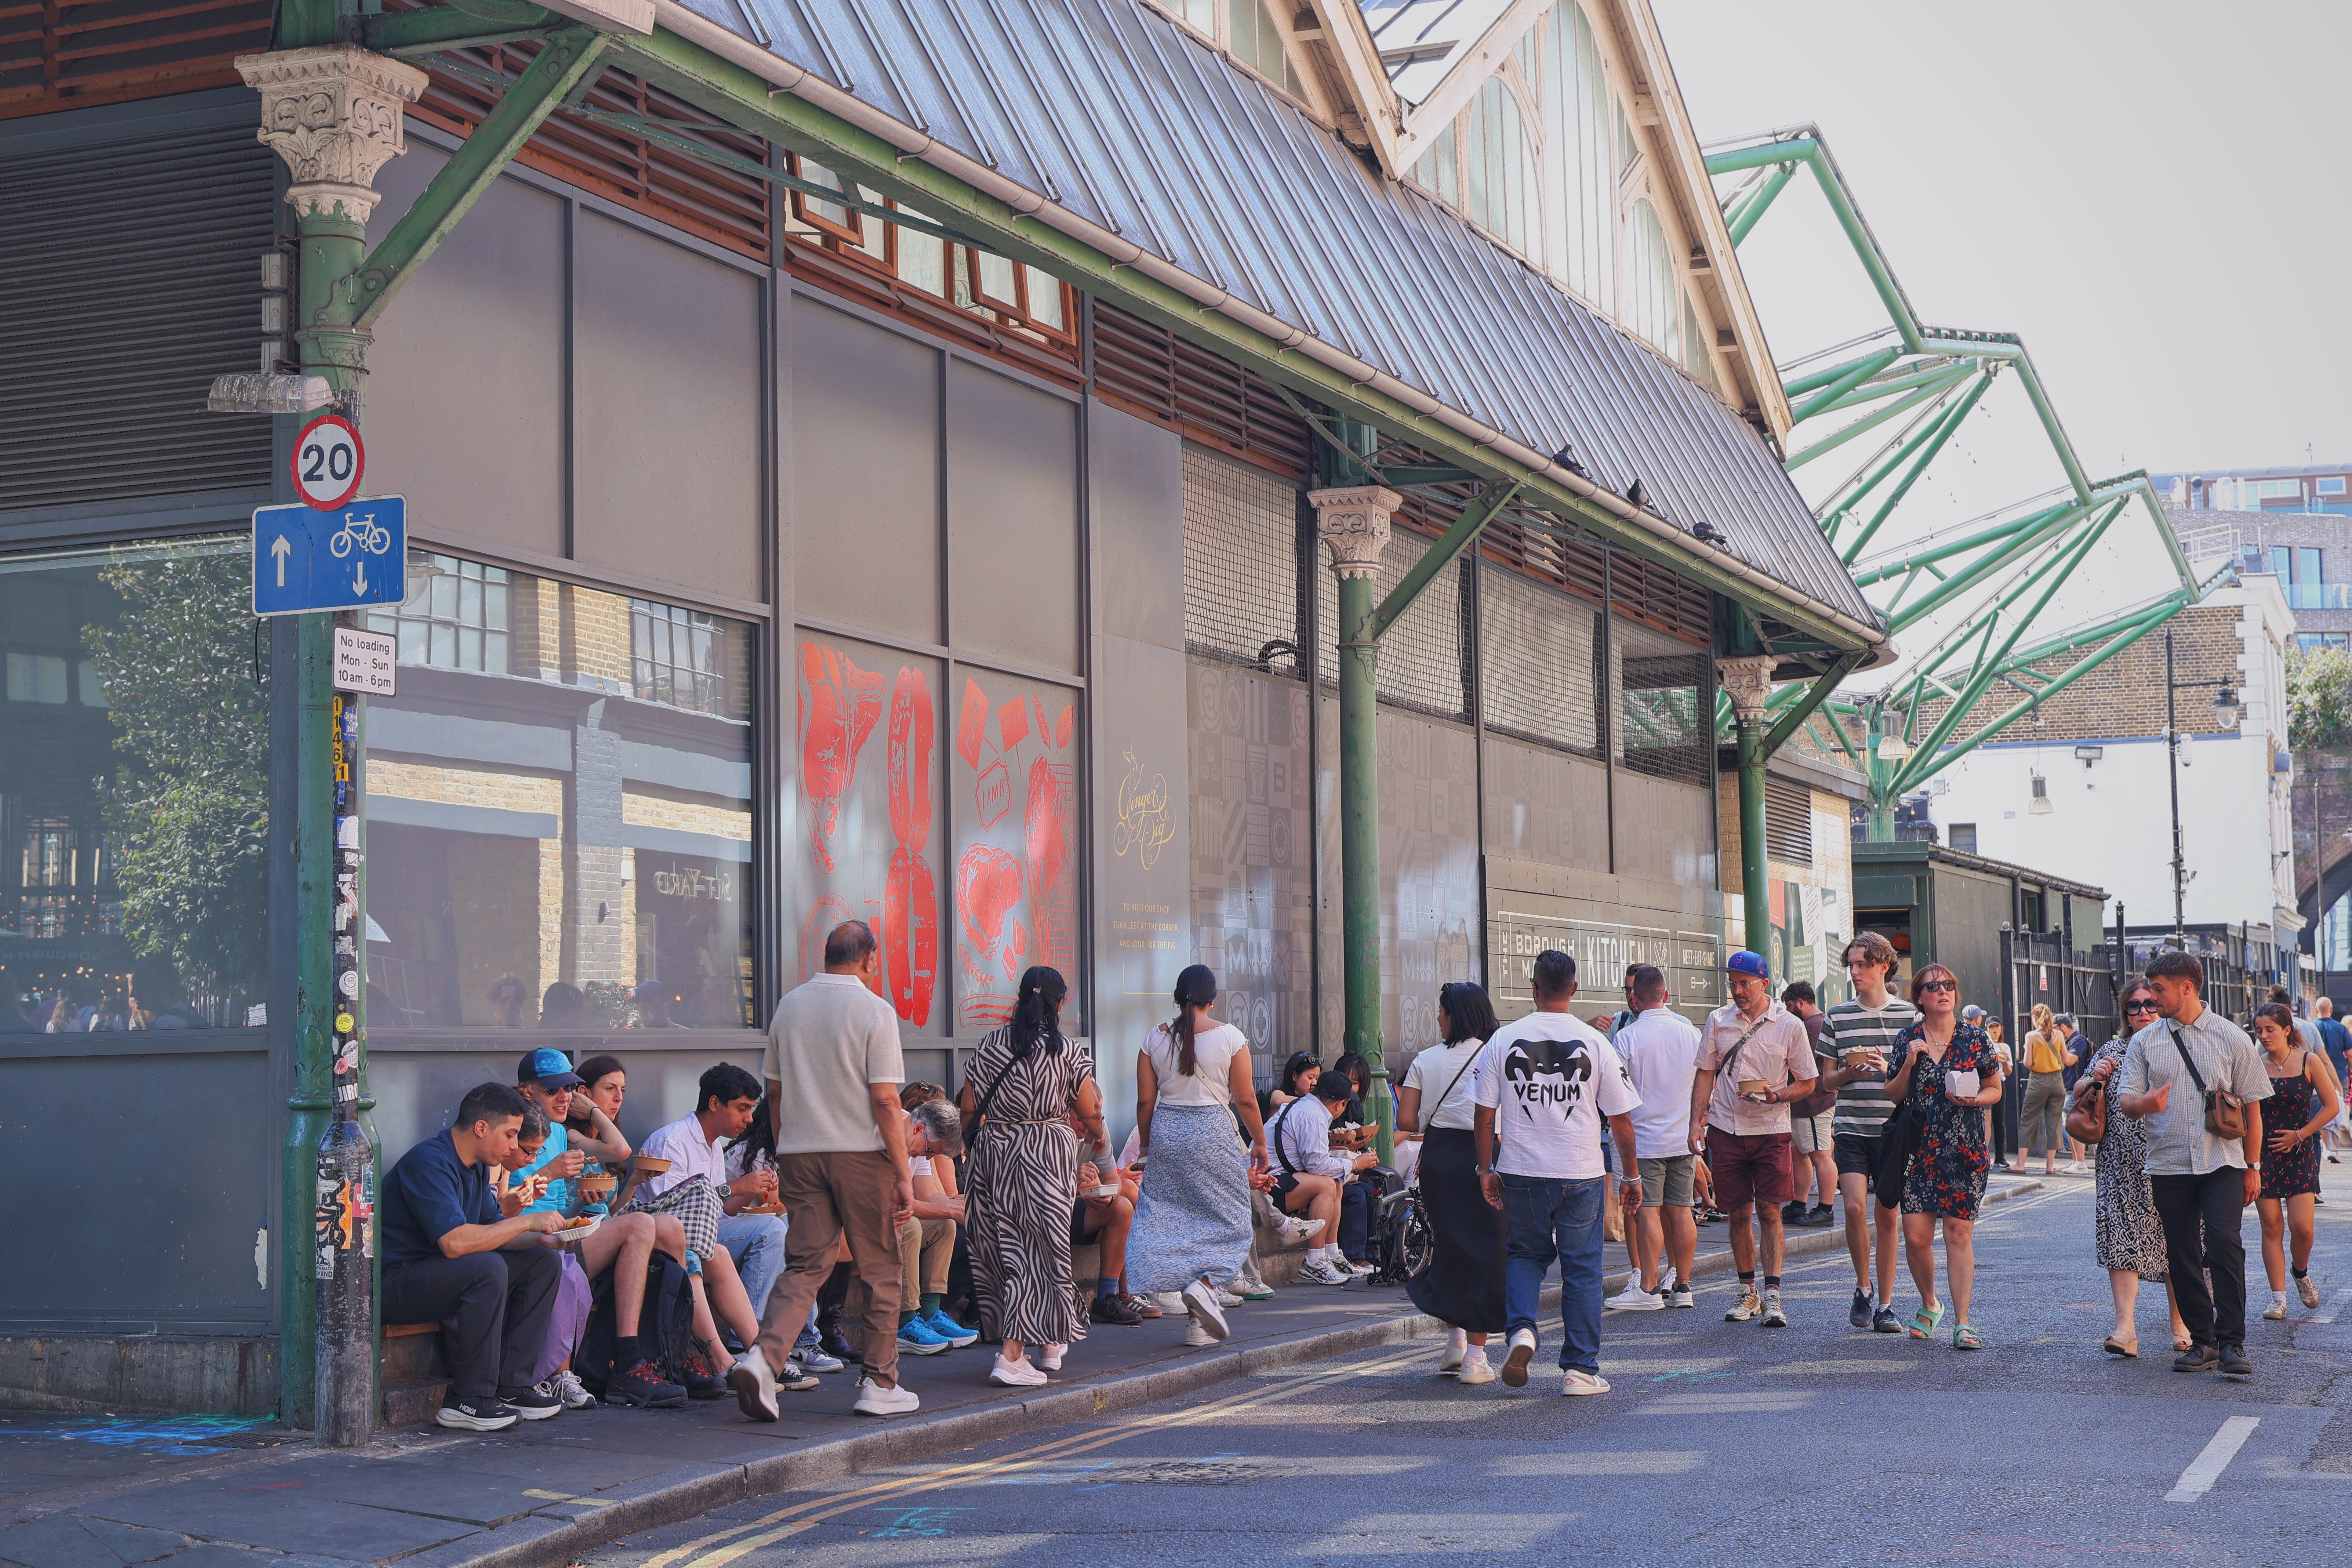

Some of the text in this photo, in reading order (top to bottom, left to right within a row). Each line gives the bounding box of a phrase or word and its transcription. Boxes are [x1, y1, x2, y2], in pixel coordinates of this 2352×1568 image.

[303, 443, 353, 482] 20
[341, 635, 390, 655] No loading
[341, 653, 360, 666] Mon
[372, 658, 388, 671] Sun
[965, 695, 980, 757] PORK
[983, 779, 1004, 810] LAMB
[1113, 921, 1127, 929] TURN
[1159, 923, 1180, 933] CORNER,
[1146, 940, 1156, 949] FOR
[1516, 935, 1574, 957] BOROUGH
[1514, 1083, 1580, 1109] VENUM
[904, 1333, 919, 1343] HOKA
[459, 1403, 477, 1415] HOKA
